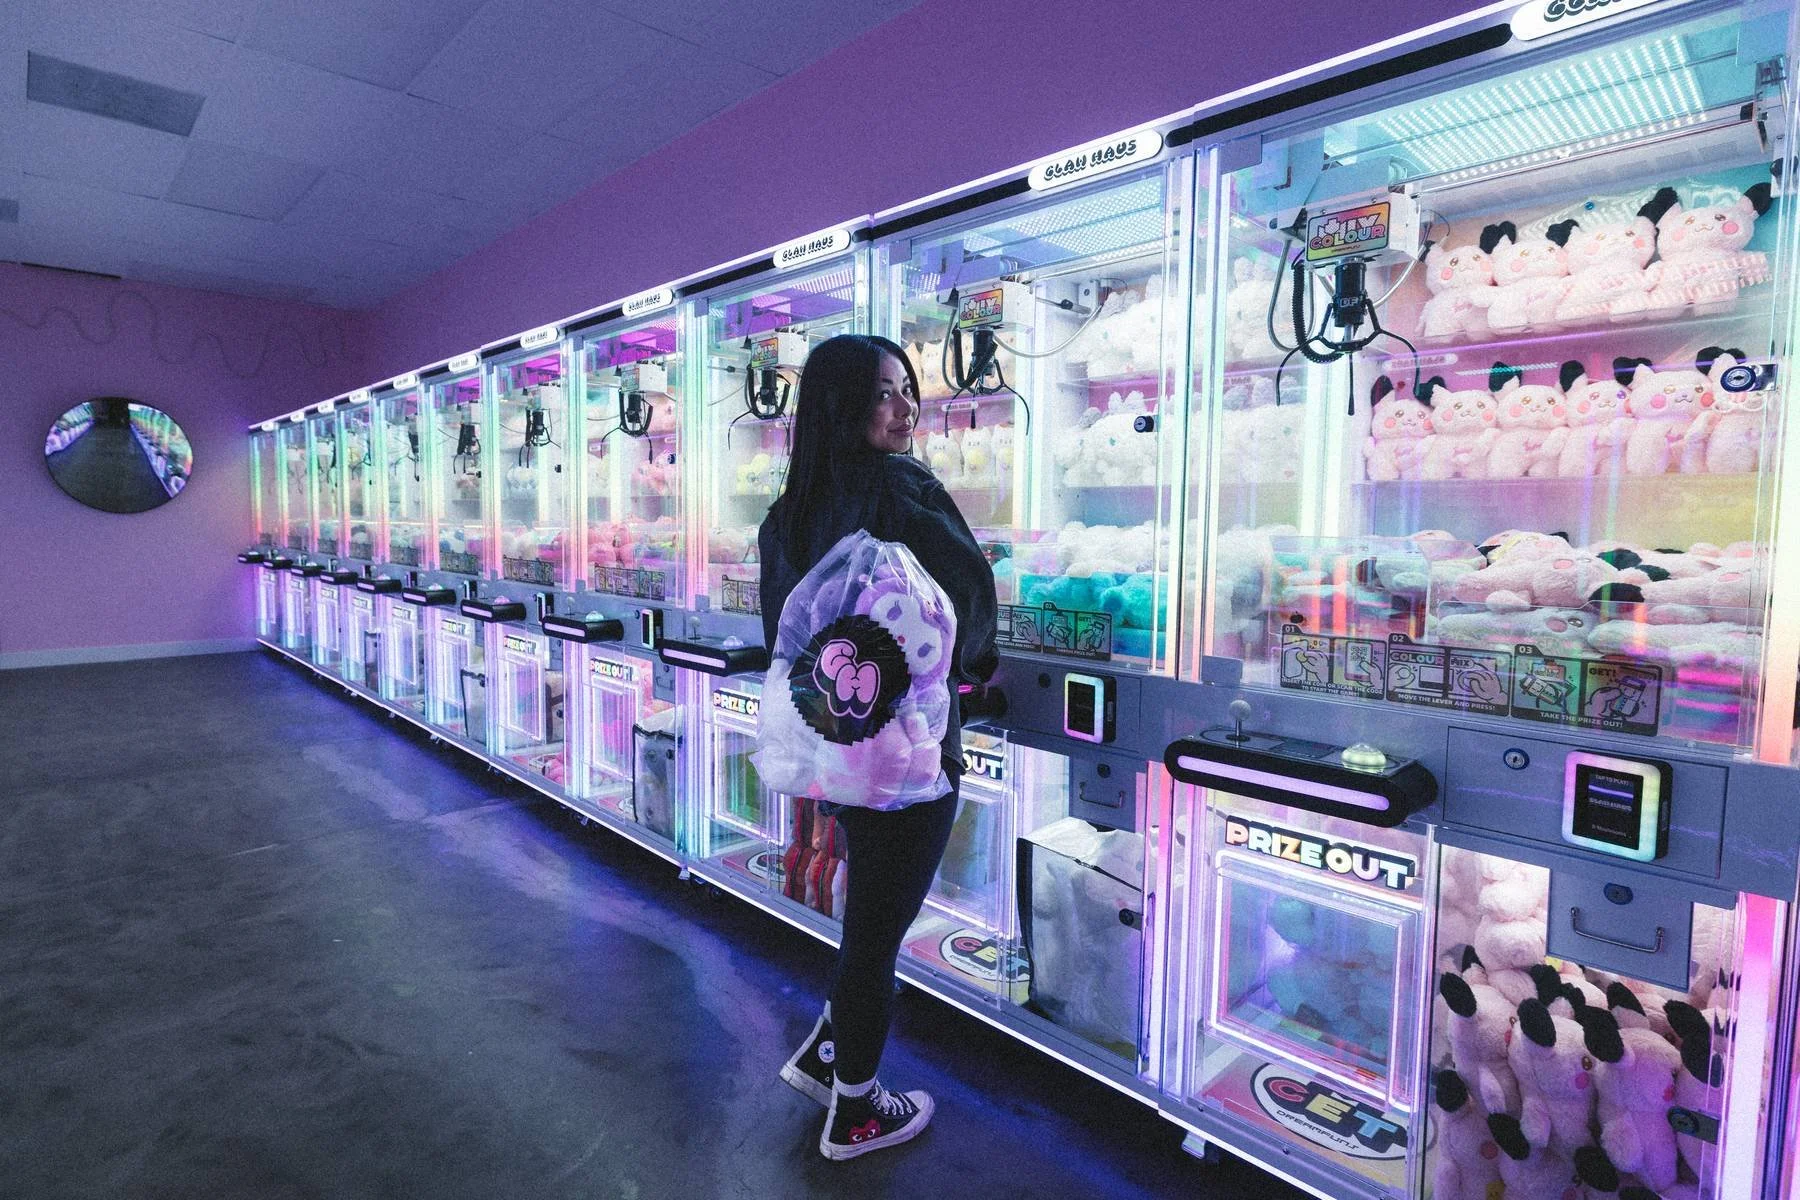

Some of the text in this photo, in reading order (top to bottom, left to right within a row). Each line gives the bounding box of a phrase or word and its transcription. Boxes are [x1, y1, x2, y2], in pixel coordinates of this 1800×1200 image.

[1089, 139, 1137, 167] HAUS
[1309, 223, 1386, 250] COLOUR
[1392, 634, 1404, 642] 02
[1519, 645, 1533, 654] 03
[1390, 652, 1444, 665] COLOUR
[1588, 667, 1617, 677] GET!
[713, 690, 746, 713] PRIZE
[1397, 693, 1495, 712] MOVE THE LEVER AND PRESS!
[1540, 712, 1623, 728] TAKE THE PRIZE OUT!
[1225, 816, 1413, 890] PRIZE OUT
